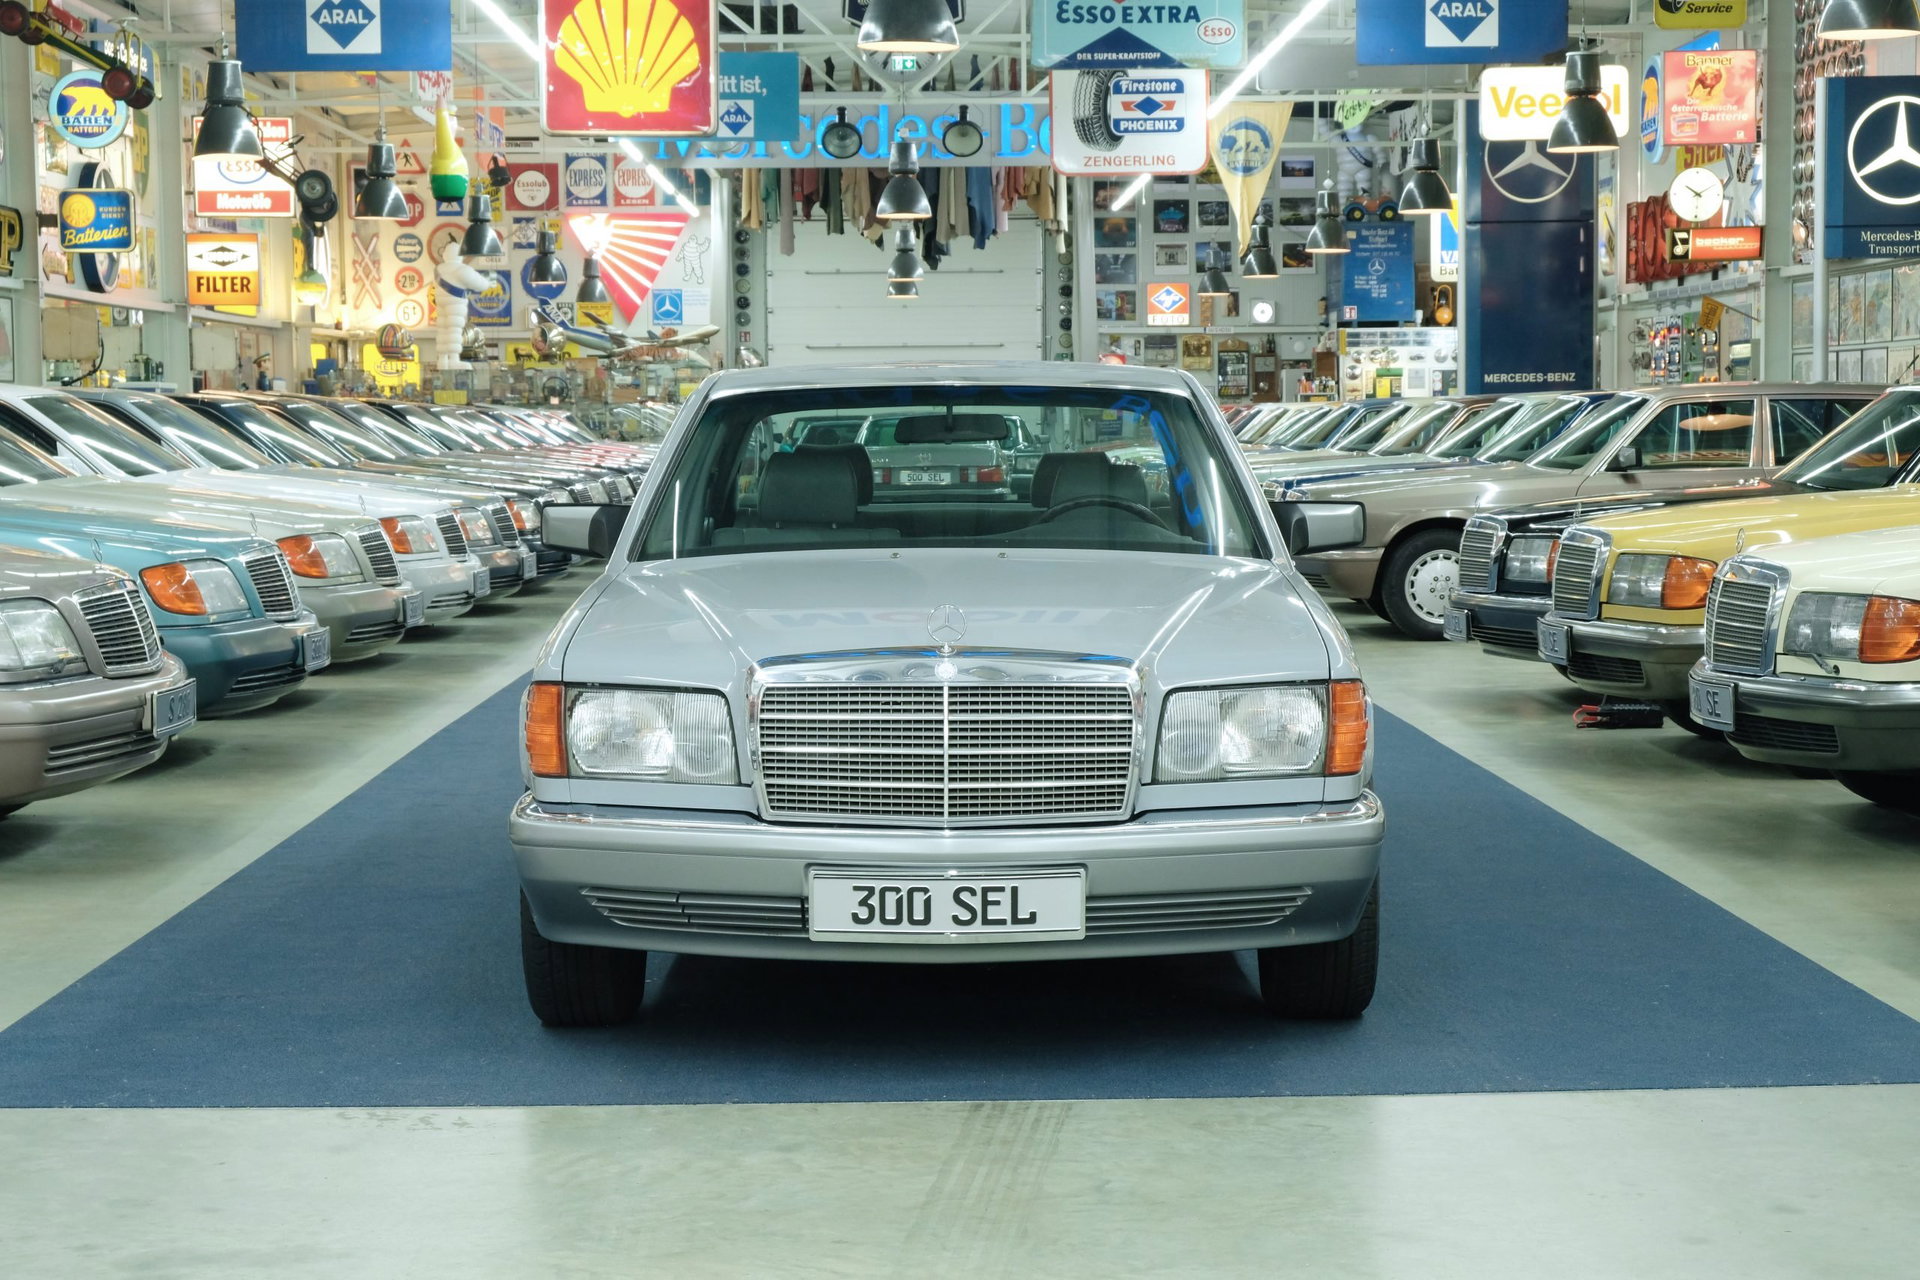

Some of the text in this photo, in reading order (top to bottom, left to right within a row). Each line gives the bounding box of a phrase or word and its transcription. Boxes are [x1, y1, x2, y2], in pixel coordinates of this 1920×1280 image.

[1121, 6, 1200, 23] EXTRA
[1437, 3, 1488, 17] ARAL
[1686, 3, 1733, 13] Service
[318, 9, 369, 24] ARAL
[1094, 52, 1161, 60] SUPER-KRAFTSTOFF
[1685, 54, 1734, 67] Banner
[719, 75, 768, 96] itt ist,
[1120, 80, 1177, 93] Firestone
[1489, 83, 1621, 118] Veel
[1701, 112, 1748, 122] Batterie
[67, 125, 108, 133] BATTERIE
[1120, 120, 1178, 131] PHOENIX
[1083, 155, 1176, 167] ZENGERLING
[516, 180, 547, 188] Essolub
[569, 168, 604, 188] EXPRESS
[617, 168, 652, 187] EXPRESS
[62, 224, 129, 246] Batterien
[1868, 243, 1920, 257] Transport
[196, 276, 252, 293] FILTER
[1152, 315, 1185, 324] FOTO
[1483, 372, 1577, 383] MERCEDES-BENZ
[907, 473, 945, 482] 500 SEL
[1705, 689, 1722, 718] SE
[851, 885, 1037, 926] 300 SEL
